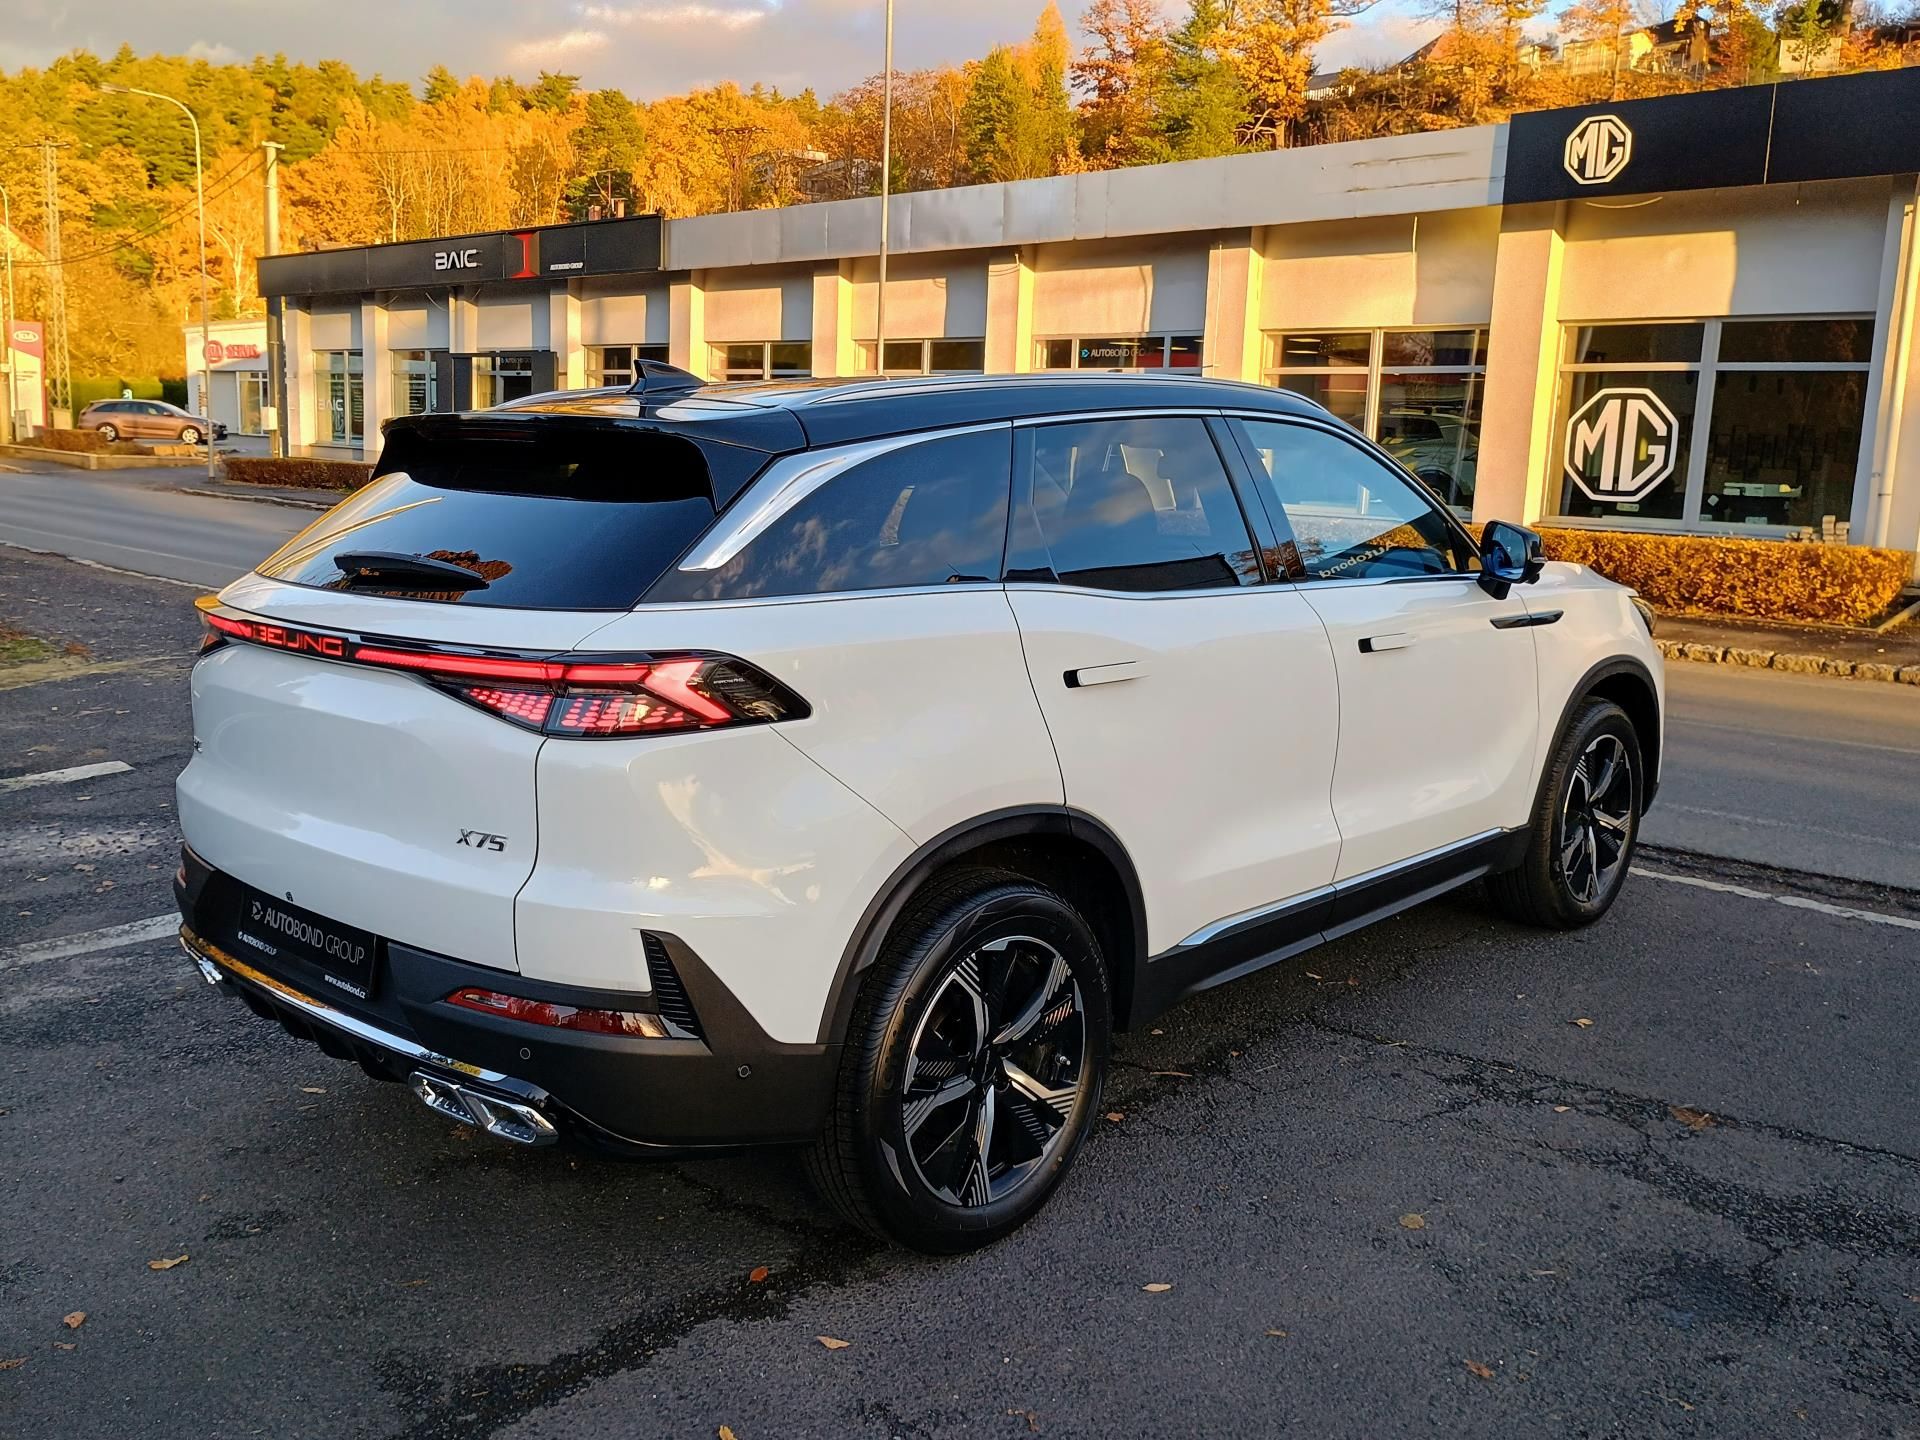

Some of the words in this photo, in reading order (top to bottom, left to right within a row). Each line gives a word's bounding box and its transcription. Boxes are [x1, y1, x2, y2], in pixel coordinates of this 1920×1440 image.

[1568, 119, 1626, 178] MG
[435, 248, 478, 271] BAIC
[1090, 348, 1129, 358] AUTOBOND
[1574, 398, 1668, 492] MG
[253, 623, 343, 657] BEIJING
[456, 828, 508, 852] X75
[264, 907, 324, 948] AUTOBOND
[325, 934, 365, 965] GROUP
[324, 973, 366, 999] www.autobond.cz
